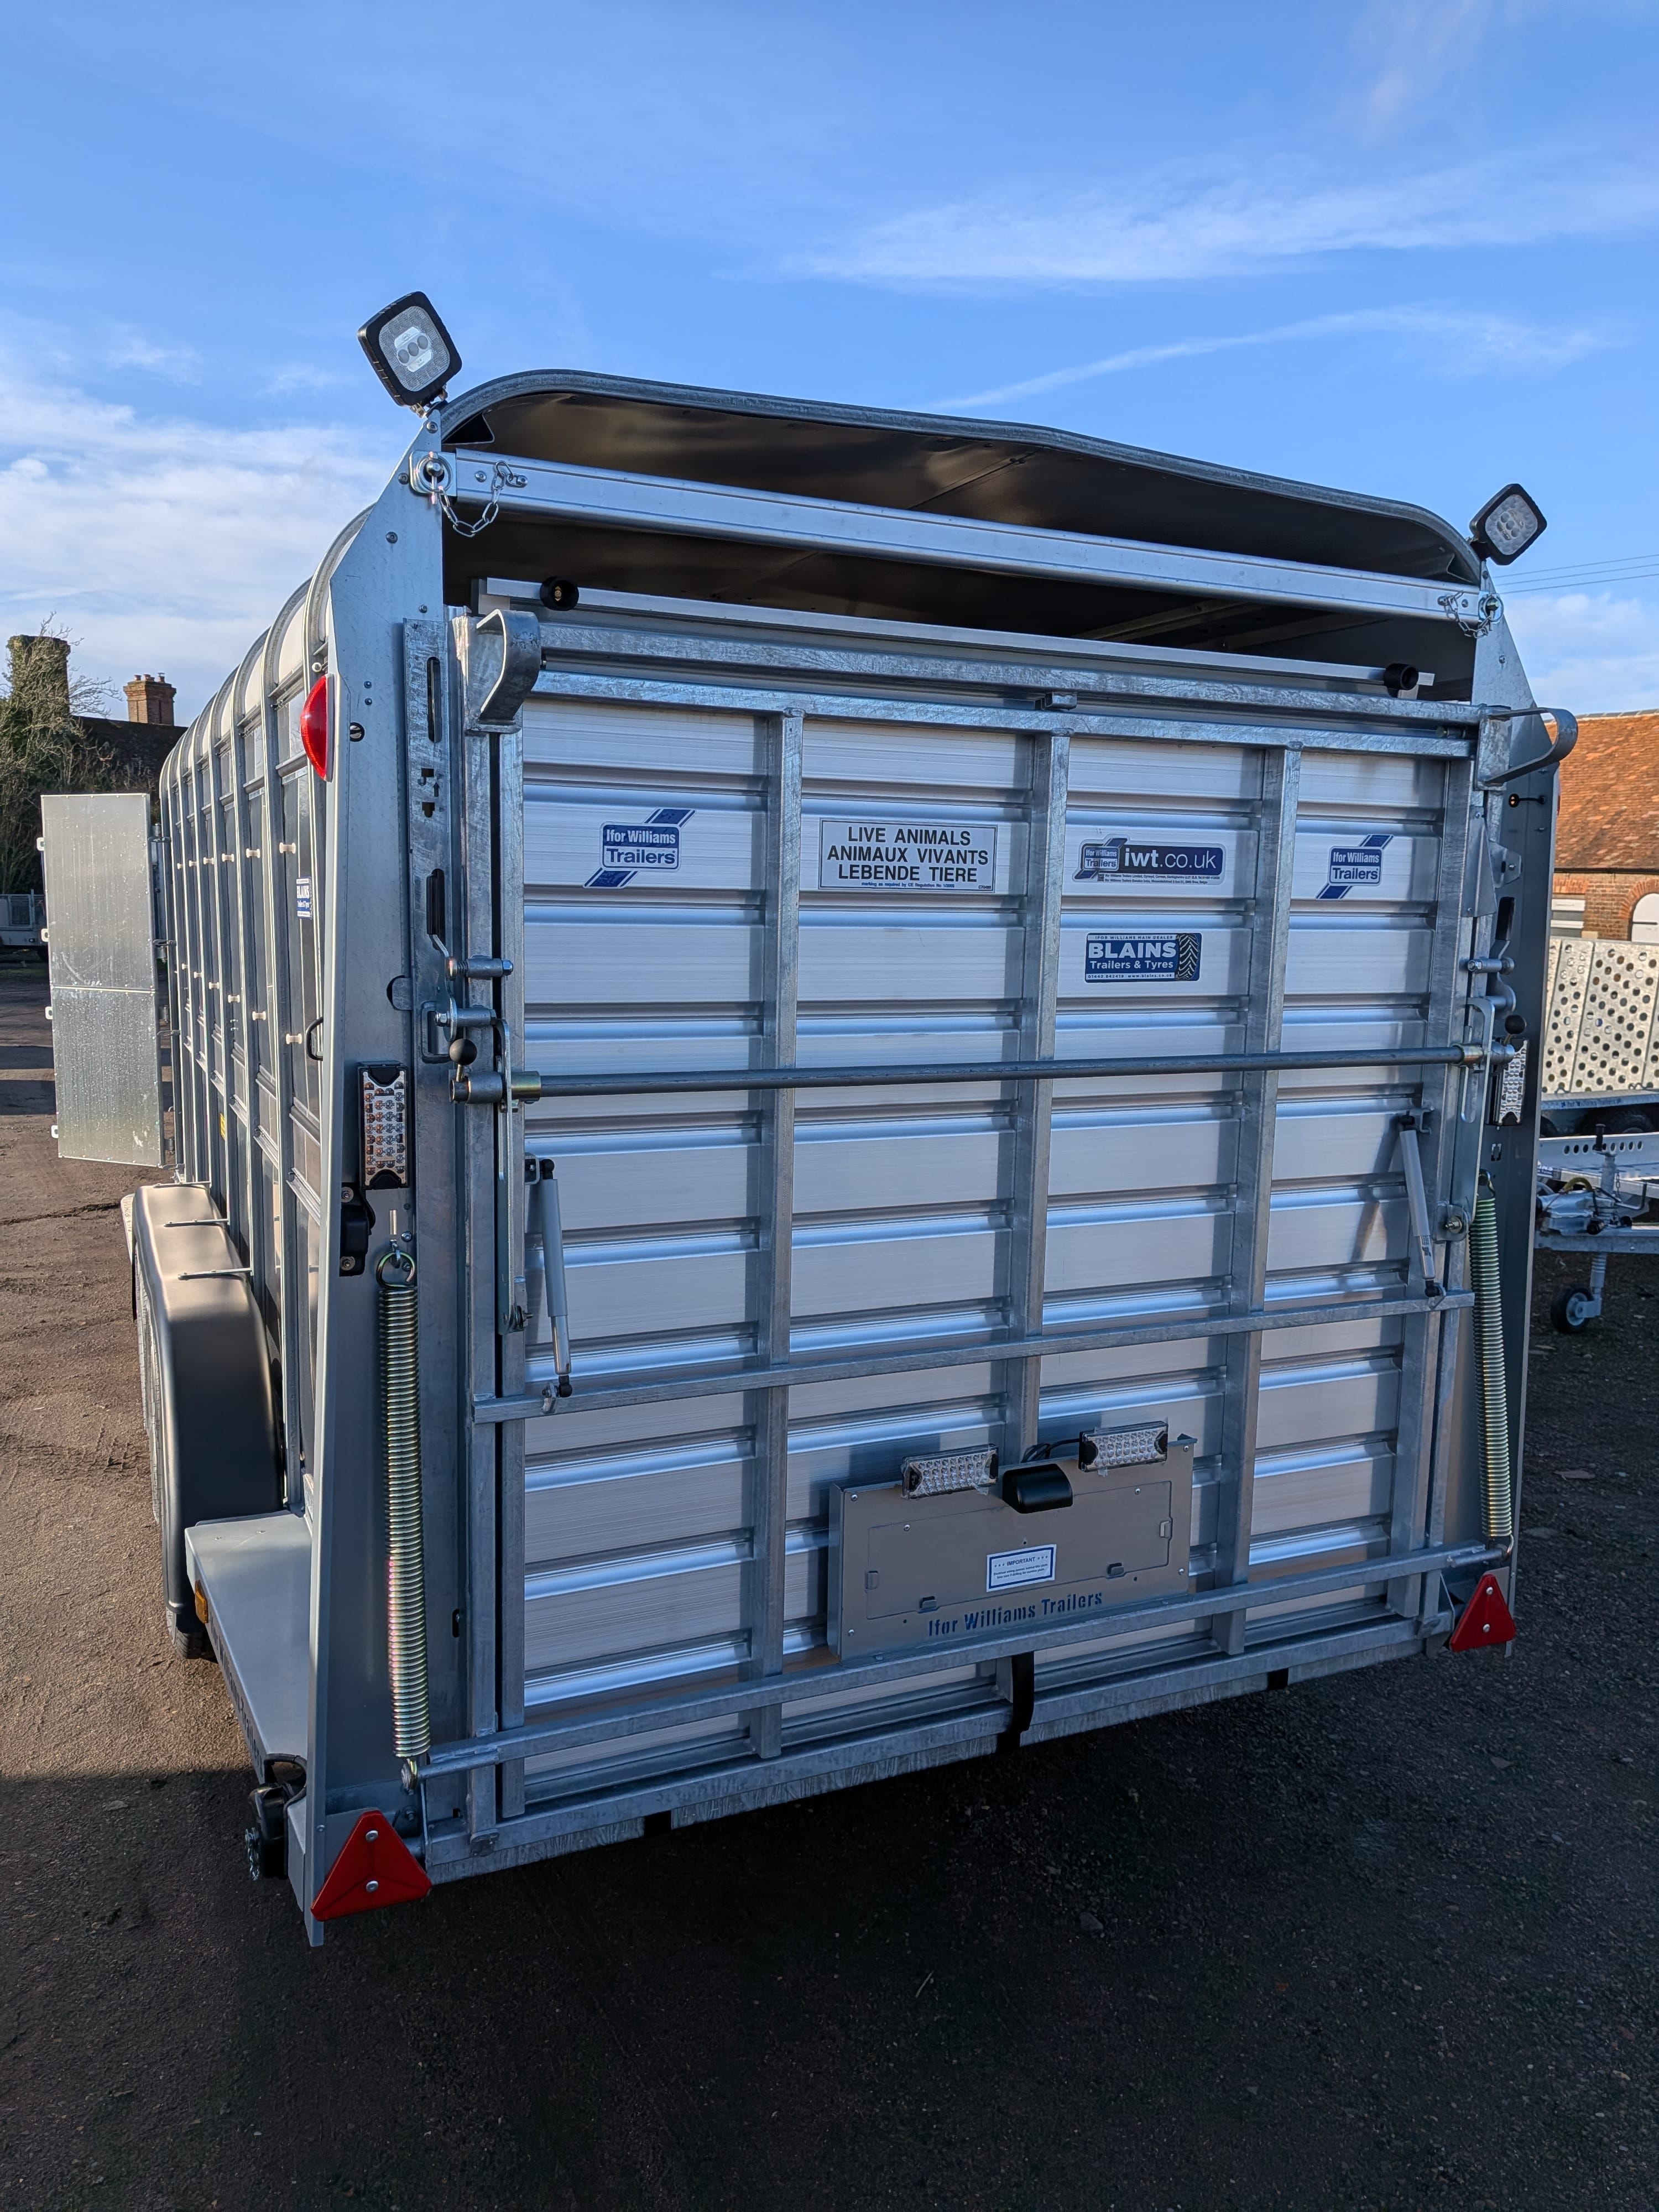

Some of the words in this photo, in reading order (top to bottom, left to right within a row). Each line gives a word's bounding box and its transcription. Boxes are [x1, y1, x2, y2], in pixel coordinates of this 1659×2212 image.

[607, 829, 625, 842] Ifor
[627, 830, 676, 844] Williams
[848, 826, 886, 842] LIVE
[894, 828, 971, 846] ANIMALS
[606, 848, 675, 864] Trailers
[827, 845, 908, 862] ANIMAUX
[917, 848, 988, 865] VIVANTS
[1086, 859, 1117, 867] Trailers
[1124, 848, 1217, 869] iwt.co.uk
[1333, 852, 1346, 862] Ifor
[1347, 852, 1379, 863] Williams
[838, 864, 920, 880] LEBENDE
[929, 867, 977, 882] TIERE
[1332, 868, 1378, 880] Trailers
[1088, 942, 1176, 958] BLAINS
[1090, 960, 1131, 969] Trailers
[1145, 960, 1173, 970] Tyres
[1006, 1557, 1035, 1566] IMPORTANT
[928, 1618, 958, 1637] Ifor
[964, 1605, 1036, 1630] Williams
[1041, 1592, 1103, 1615] Trailers
